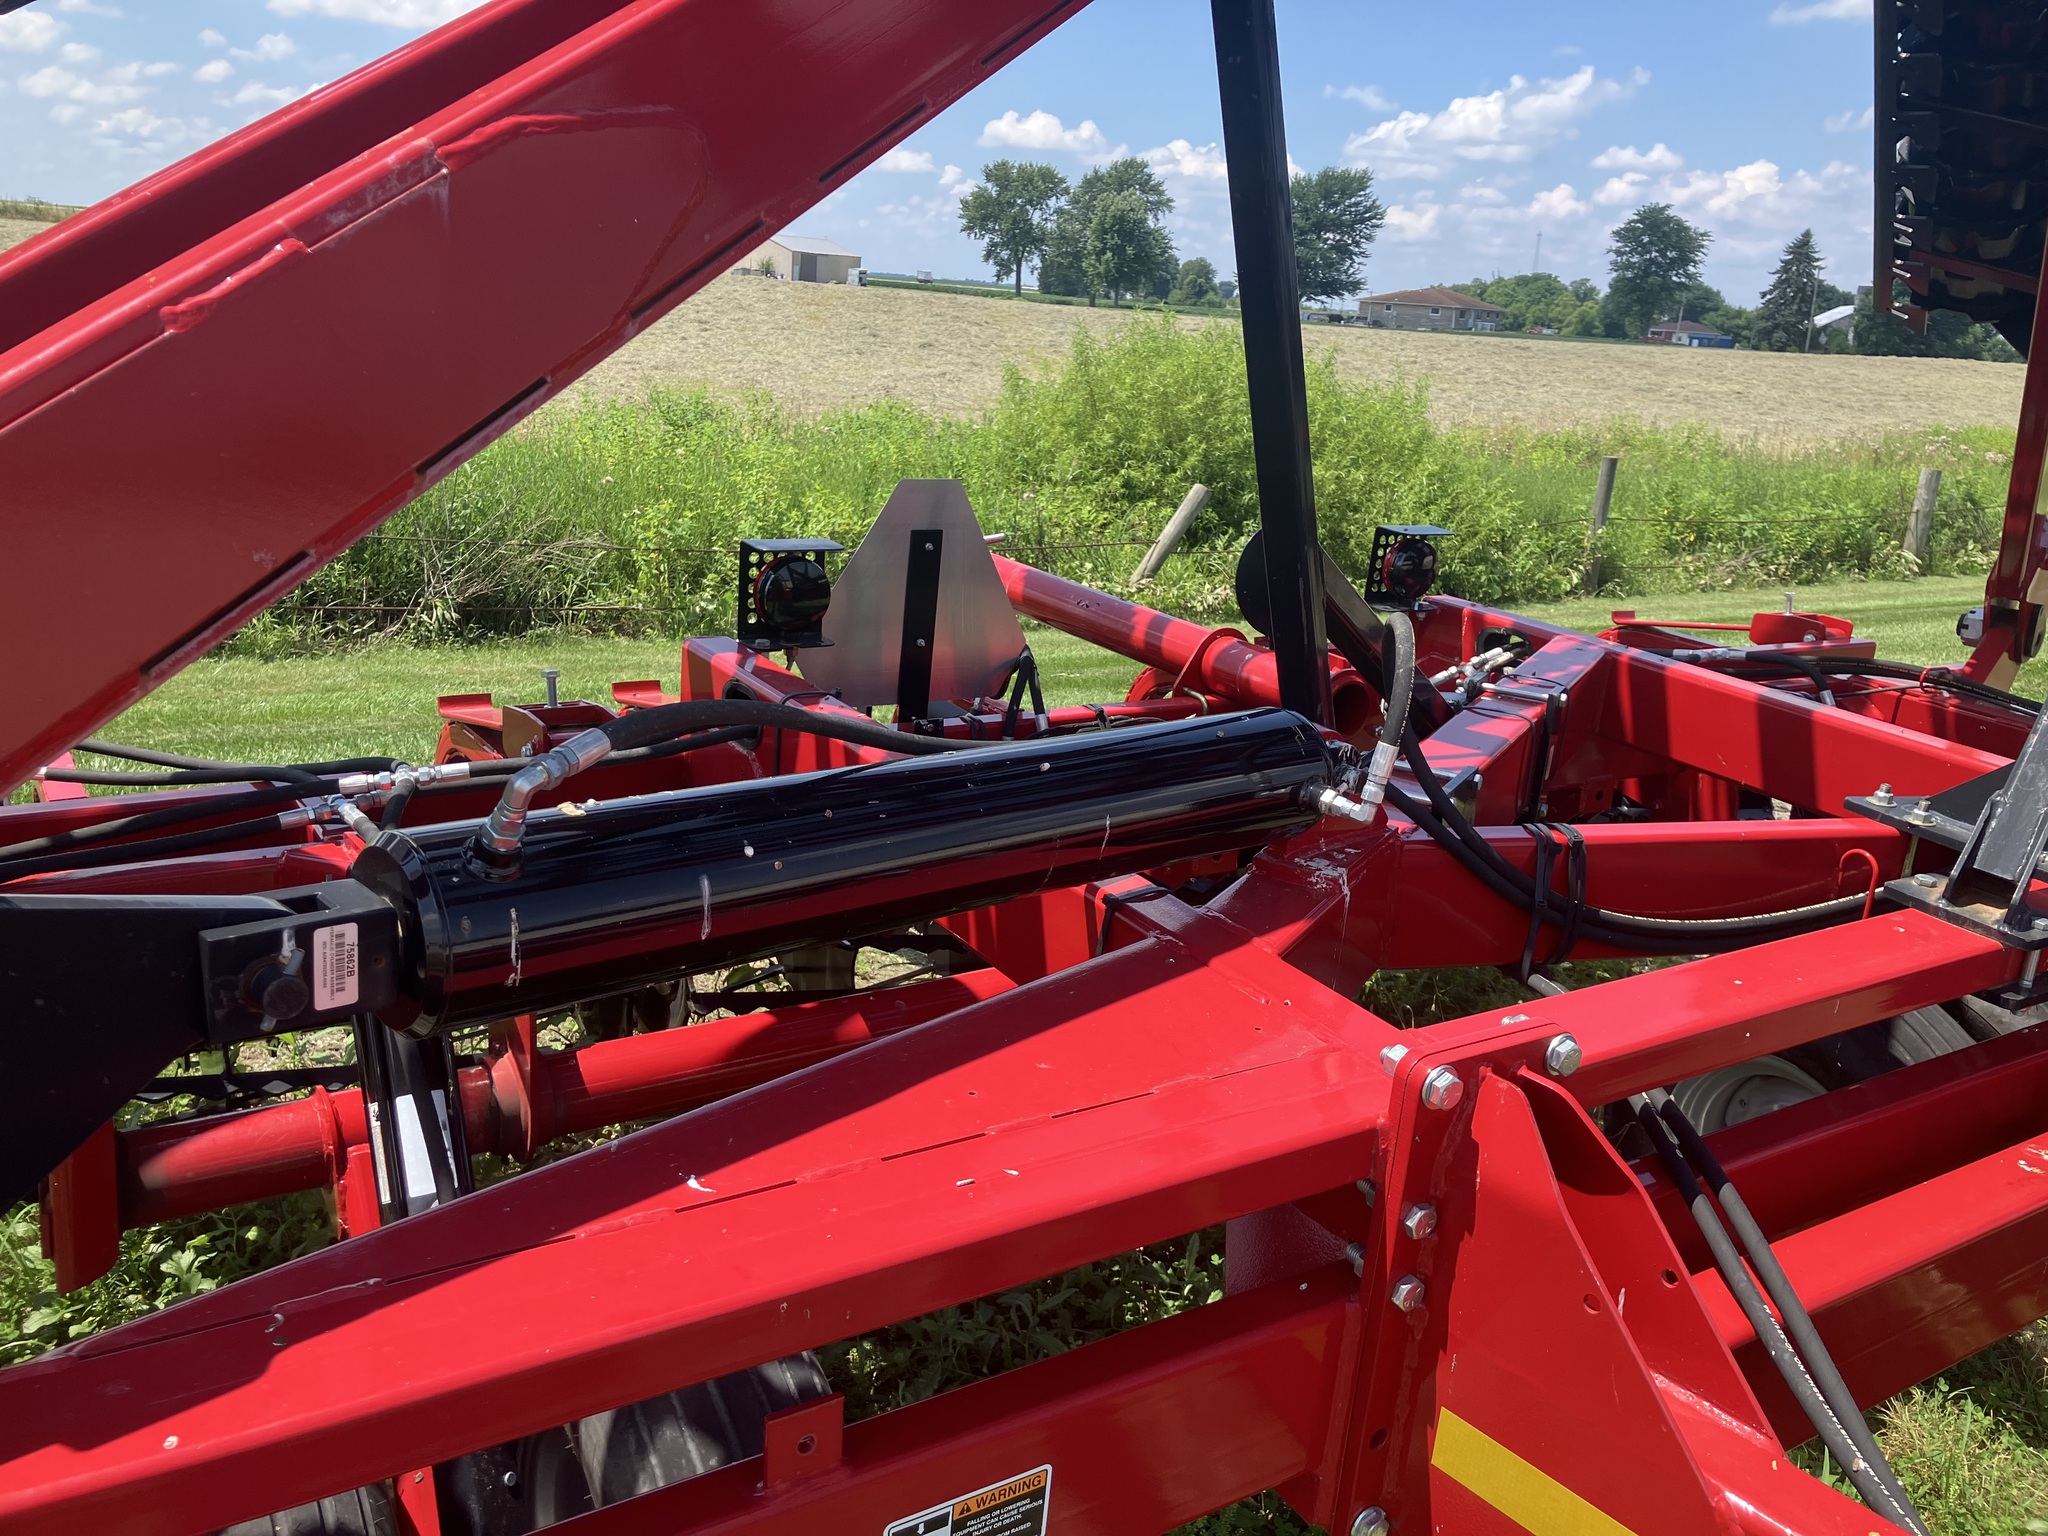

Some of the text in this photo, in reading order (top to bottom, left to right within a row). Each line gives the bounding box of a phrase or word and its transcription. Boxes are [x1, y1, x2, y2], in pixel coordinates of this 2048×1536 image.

[346, 942, 355, 977] 75862B
[1793, 1355, 1807, 1372] NO.
[1804, 1374, 1825, 1402] MSHA
[1822, 1402, 1863, 1459] RESISTANT
[976, 1475, 1042, 1509] WARNING
[1863, 1461, 1891, 1496] FLAME
[952, 1499, 1043, 1536] EQUIPMENT CAN CAUSE SERIOUS
[967, 1498, 1031, 1527] FALLING OR LOWERING
[1889, 1498, 1906, 1515] PSI
[972, 1525, 993, 1536] INJURY
[993, 1521, 1002, 1529] OR
[1010, 1521, 1032, 1534] RAISED
